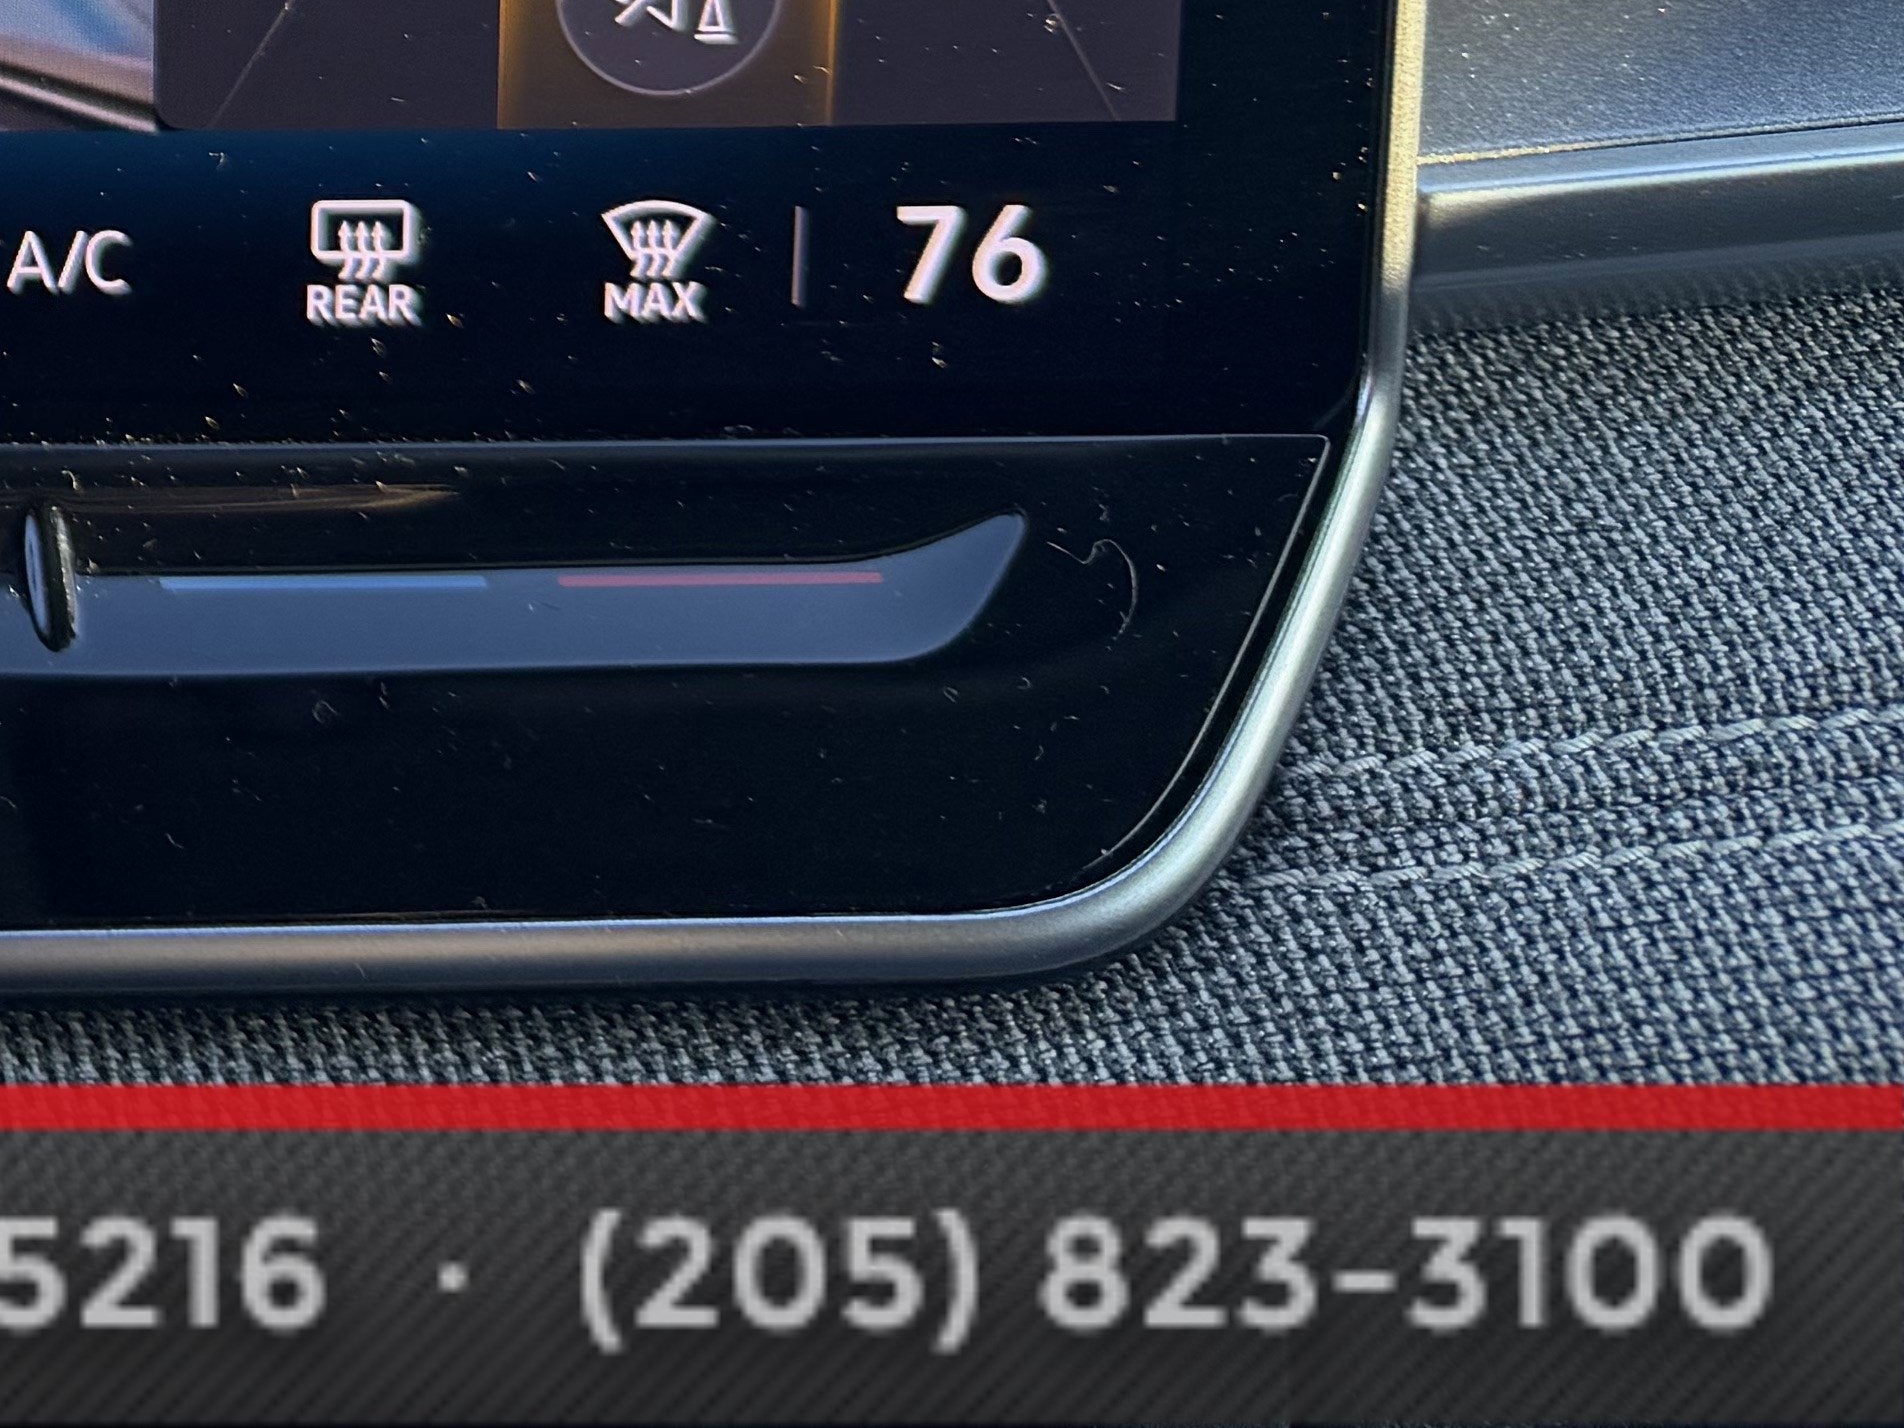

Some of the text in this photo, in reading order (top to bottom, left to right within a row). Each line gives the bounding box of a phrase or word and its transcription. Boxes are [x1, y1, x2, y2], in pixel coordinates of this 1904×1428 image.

[5, 229, 130, 295] A/C
[895, 204, 1047, 304] 76
[306, 283, 421, 325] REAR
[603, 281, 704, 321] MAX
